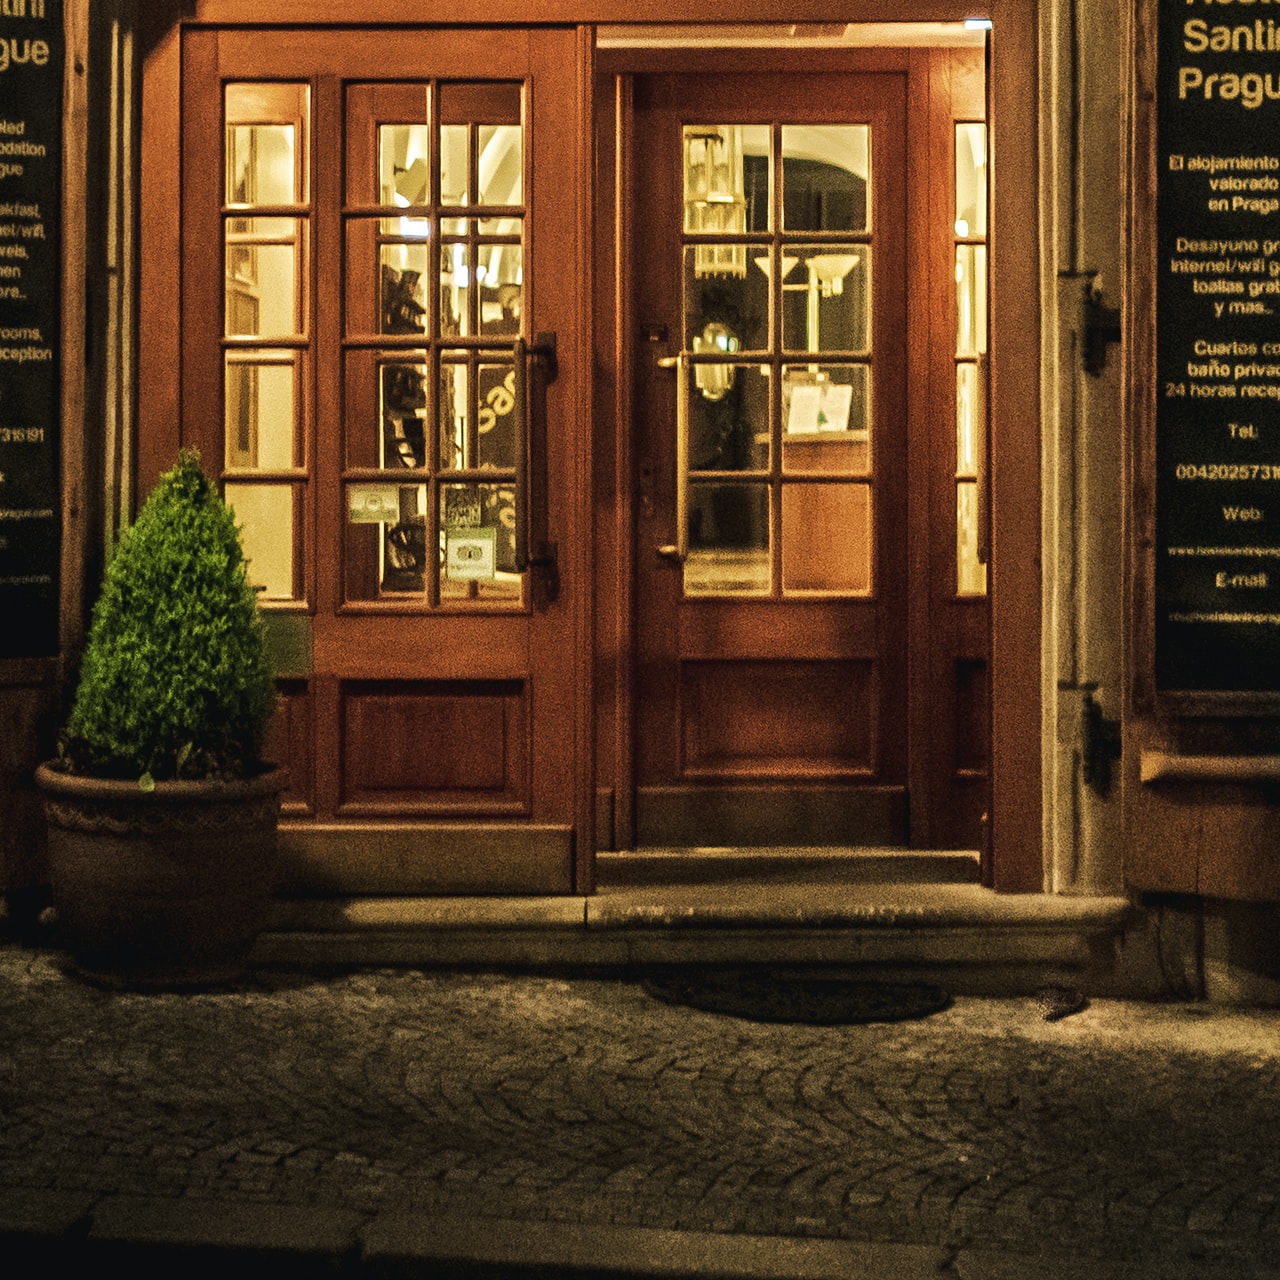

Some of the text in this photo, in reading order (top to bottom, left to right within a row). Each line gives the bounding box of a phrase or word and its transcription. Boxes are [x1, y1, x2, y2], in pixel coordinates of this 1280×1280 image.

[1168, 154, 1184, 171] El
[1187, 154, 1280, 174] alojamiento
[1208, 176, 1280, 192] valorado
[1207, 196, 1280, 215] en Praga
[1176, 237, 1259, 256] Desayuno
[1192, 278, 1245, 294] toallas
[1214, 301, 1225, 319] y
[1193, 339, 1259, 357] Cuartos
[1187, 359, 1231, 378] baño
[1165, 381, 1186, 398] 24
[1190, 381, 1237, 398] horas
